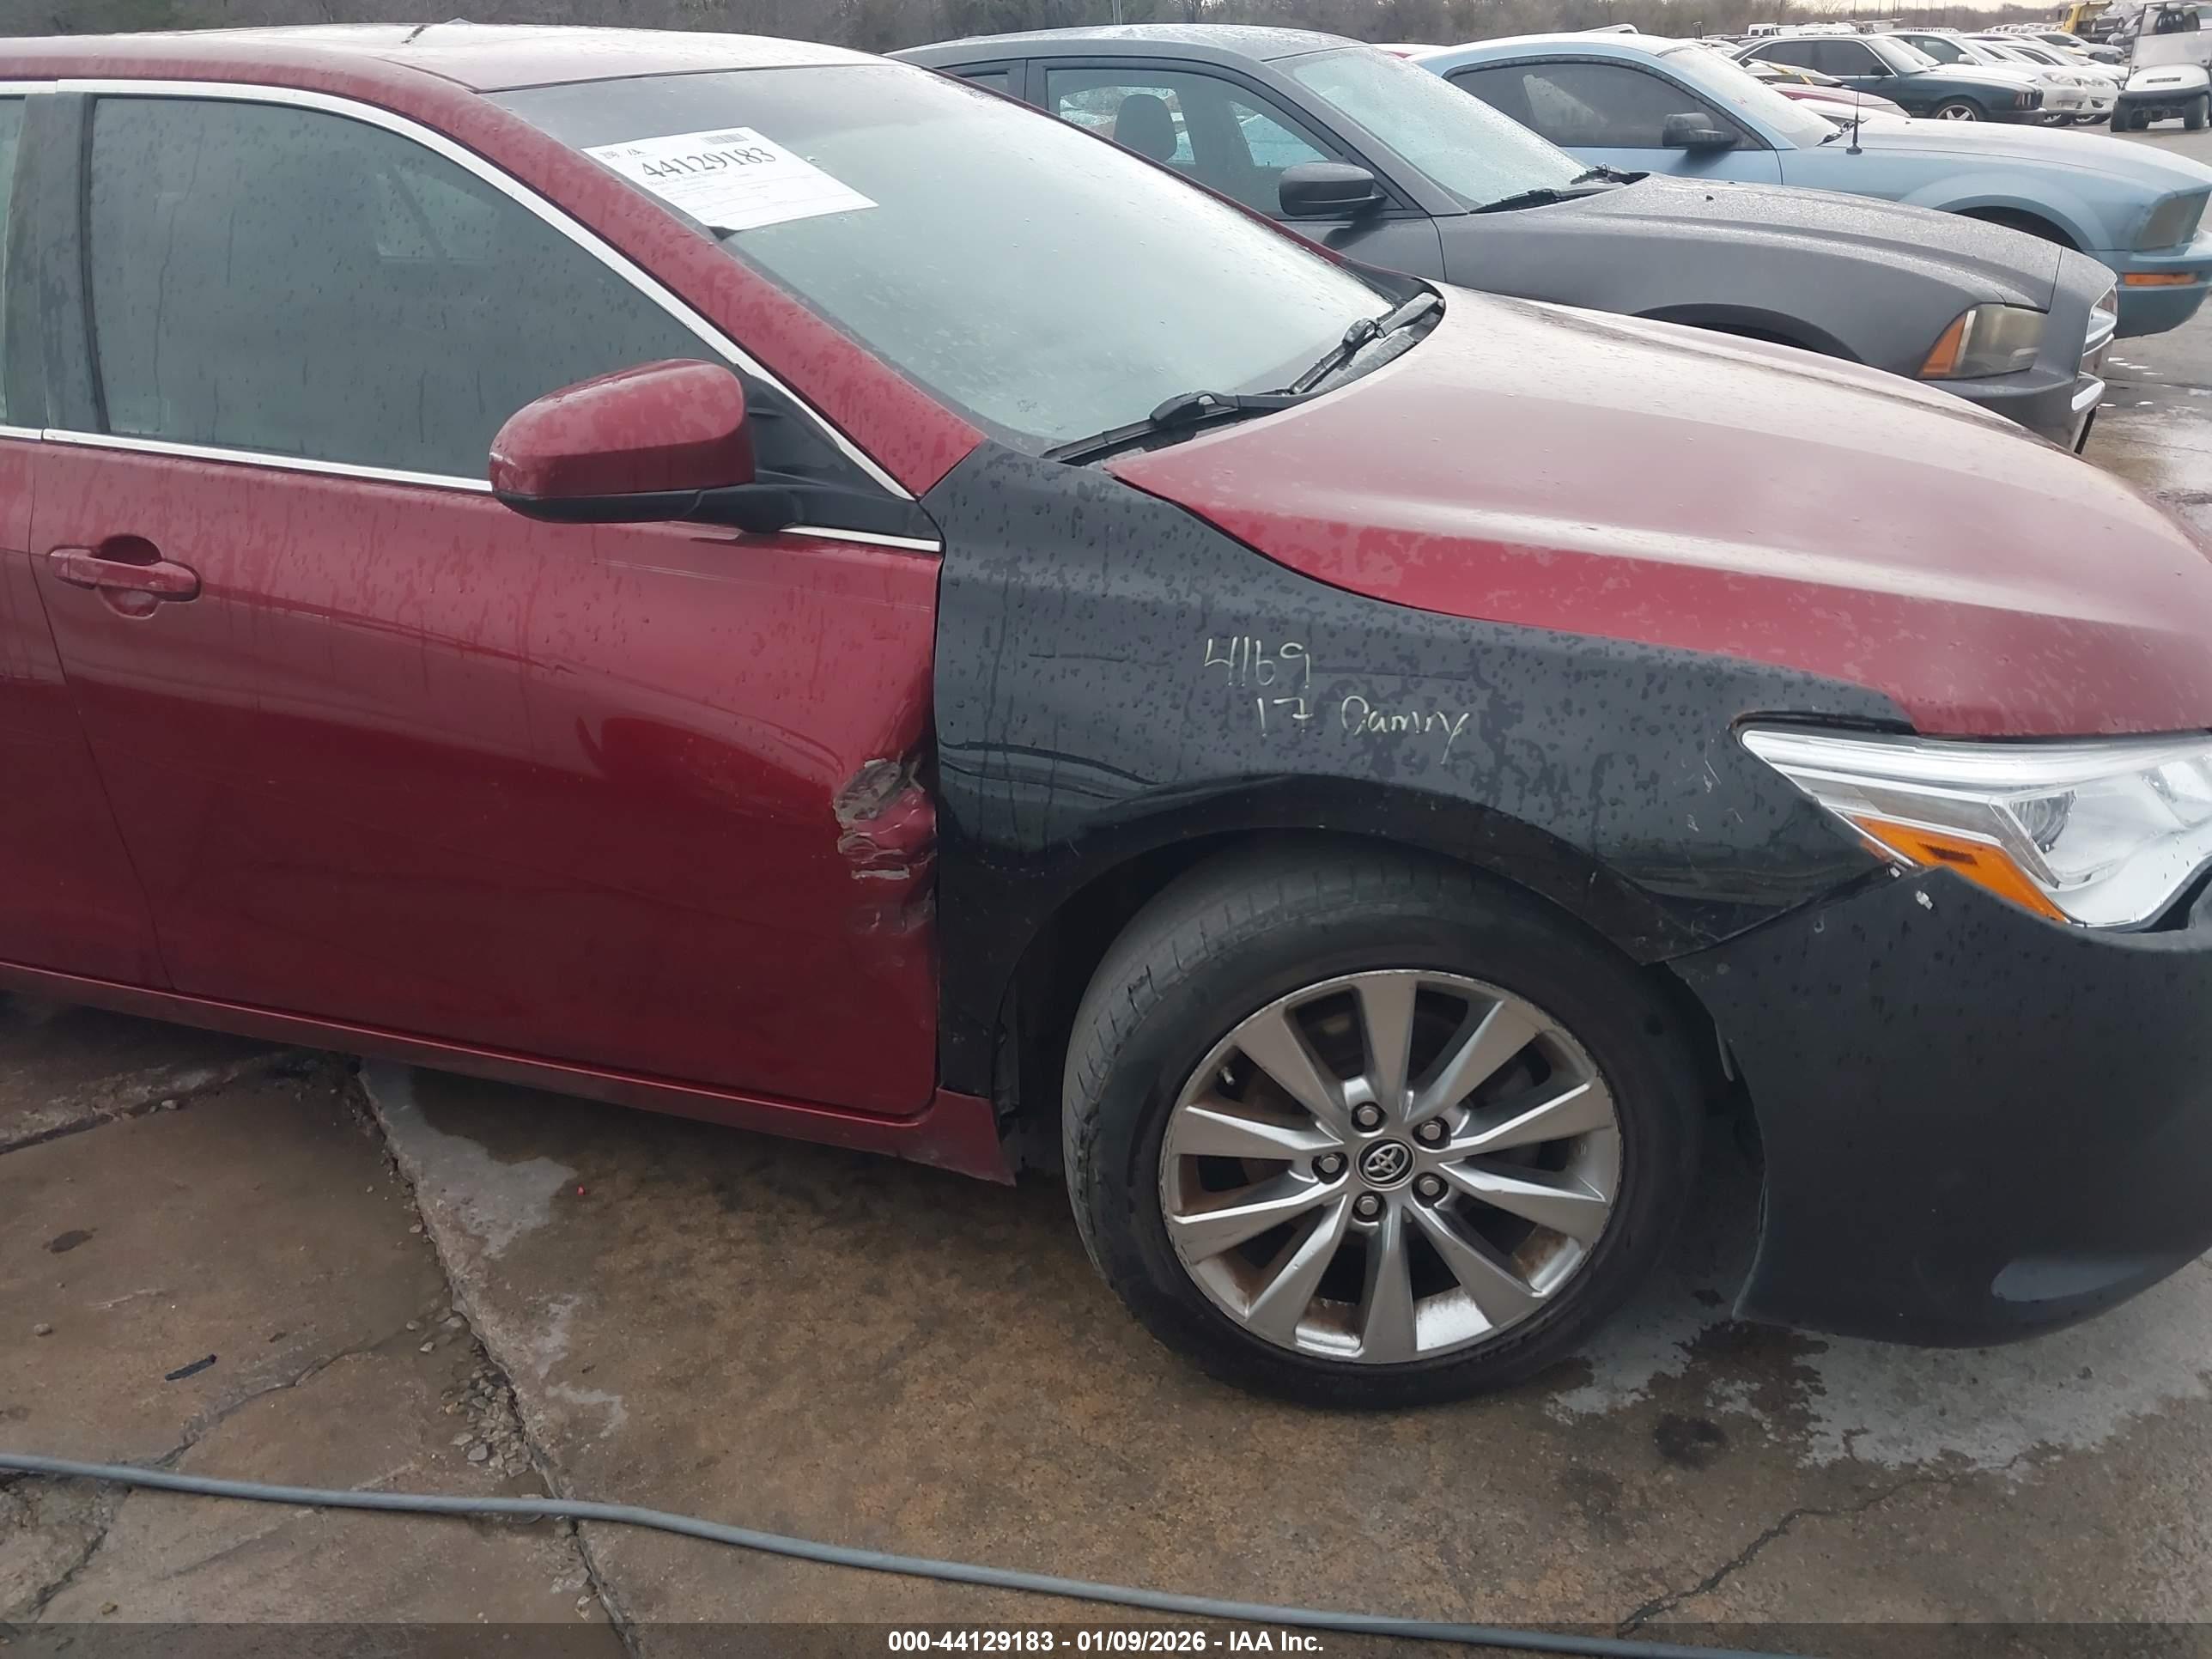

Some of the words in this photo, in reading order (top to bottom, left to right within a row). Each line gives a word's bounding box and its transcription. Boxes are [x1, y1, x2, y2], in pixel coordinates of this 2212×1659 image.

[641, 147, 776, 178] 44129183
[1204, 635, 1311, 689] 4169
[1256, 696, 1315, 737] 17
